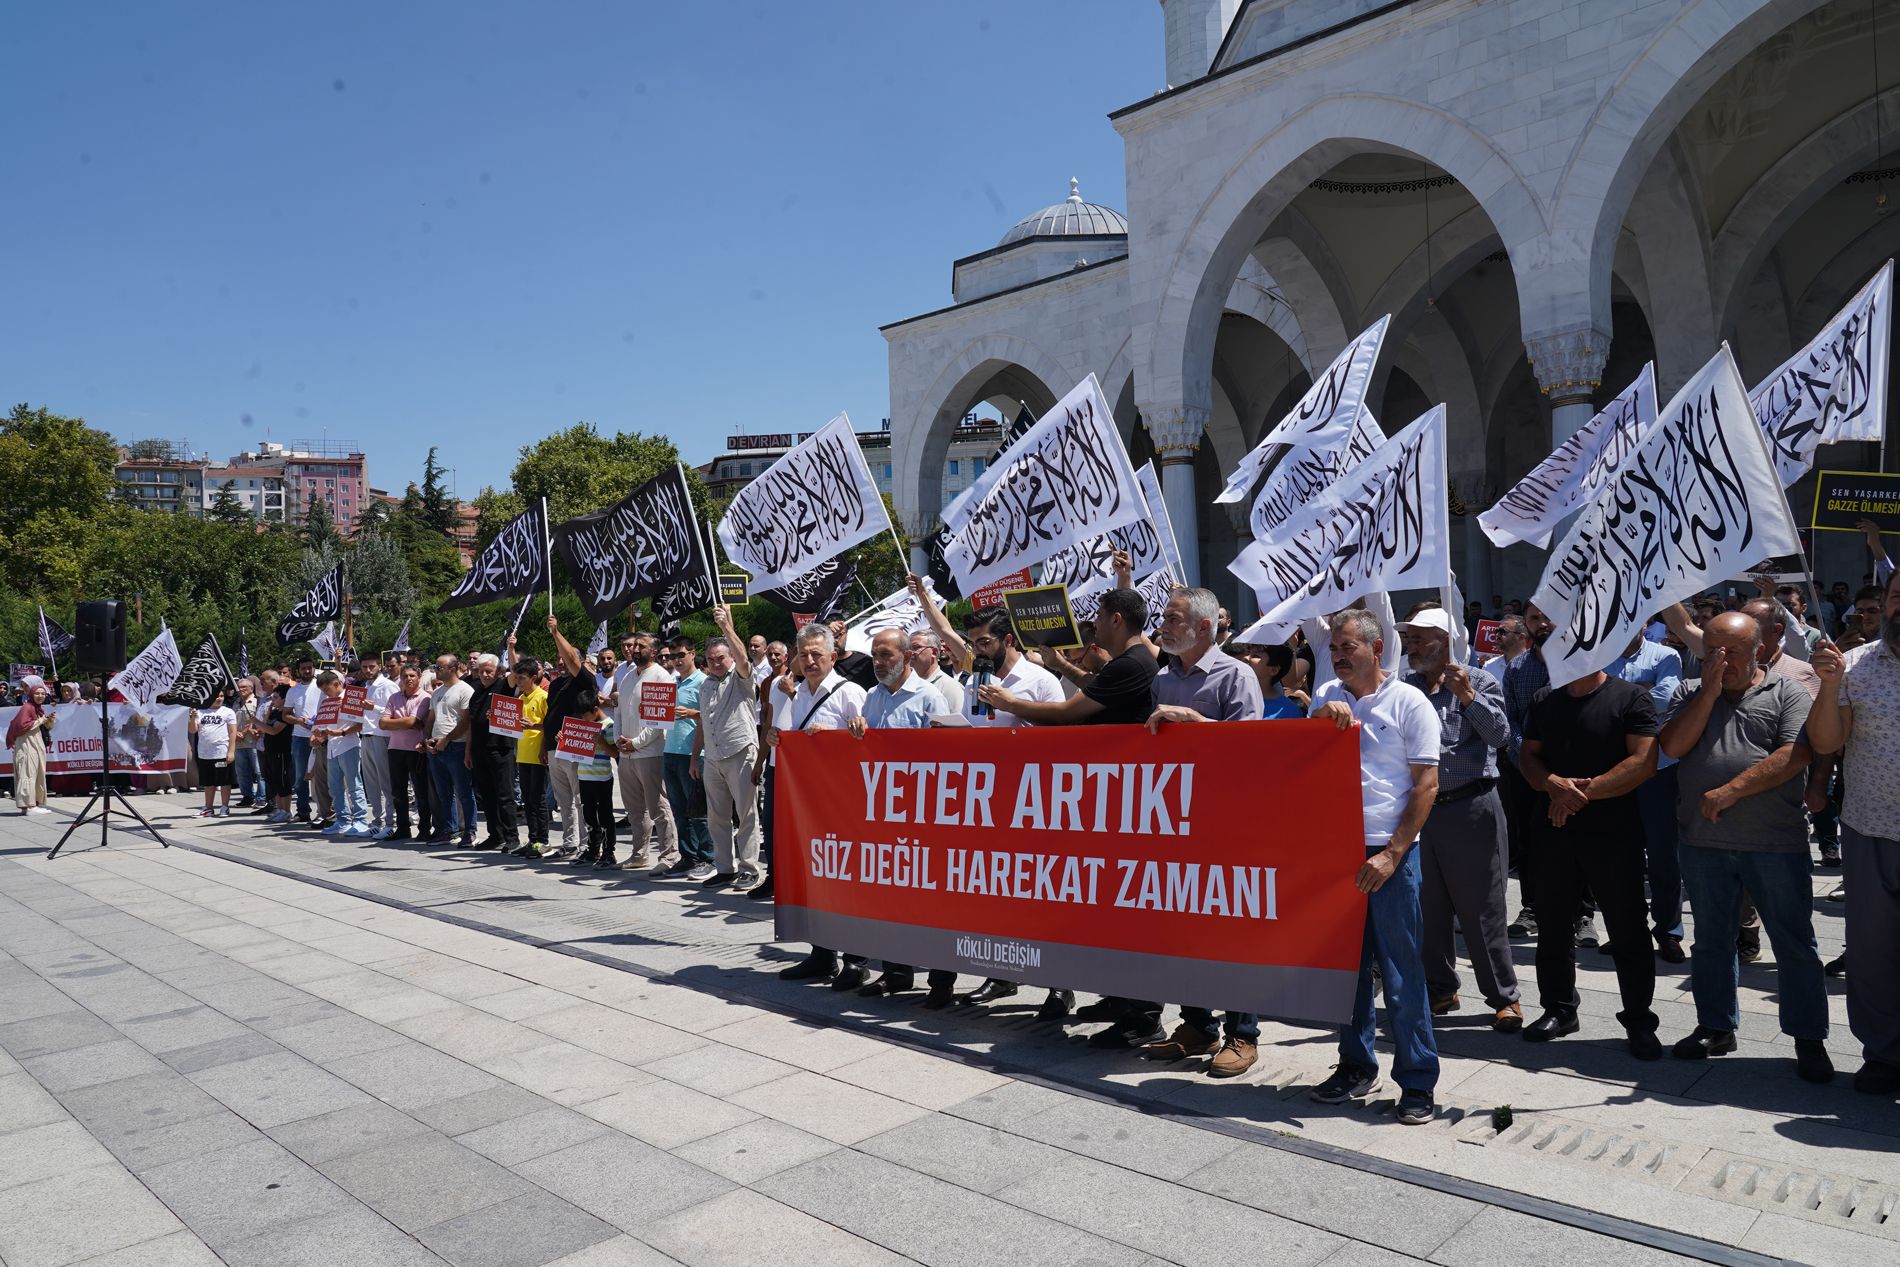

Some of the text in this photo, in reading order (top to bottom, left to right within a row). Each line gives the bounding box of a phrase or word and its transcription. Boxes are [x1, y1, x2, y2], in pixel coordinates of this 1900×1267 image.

[727, 434, 792, 449] DEVRAN
[1832, 488, 1900, 499] SEN YAŞARKE
[1827, 500, 1859, 512] GAZZE
[974, 589, 993, 599] KADAR
[1027, 604, 1061, 616] YAŞARKEN
[1035, 614, 1067, 631] ÖLMESİN
[860, 761, 1195, 836] YETER ARTIK!
[811, 833, 1278, 920] SÖZ DEĞİL HAREKAT ZAMANI
[956, 936, 991, 960] KÖKLÜ
[993, 941, 1041, 968] DEĞİŞİM
